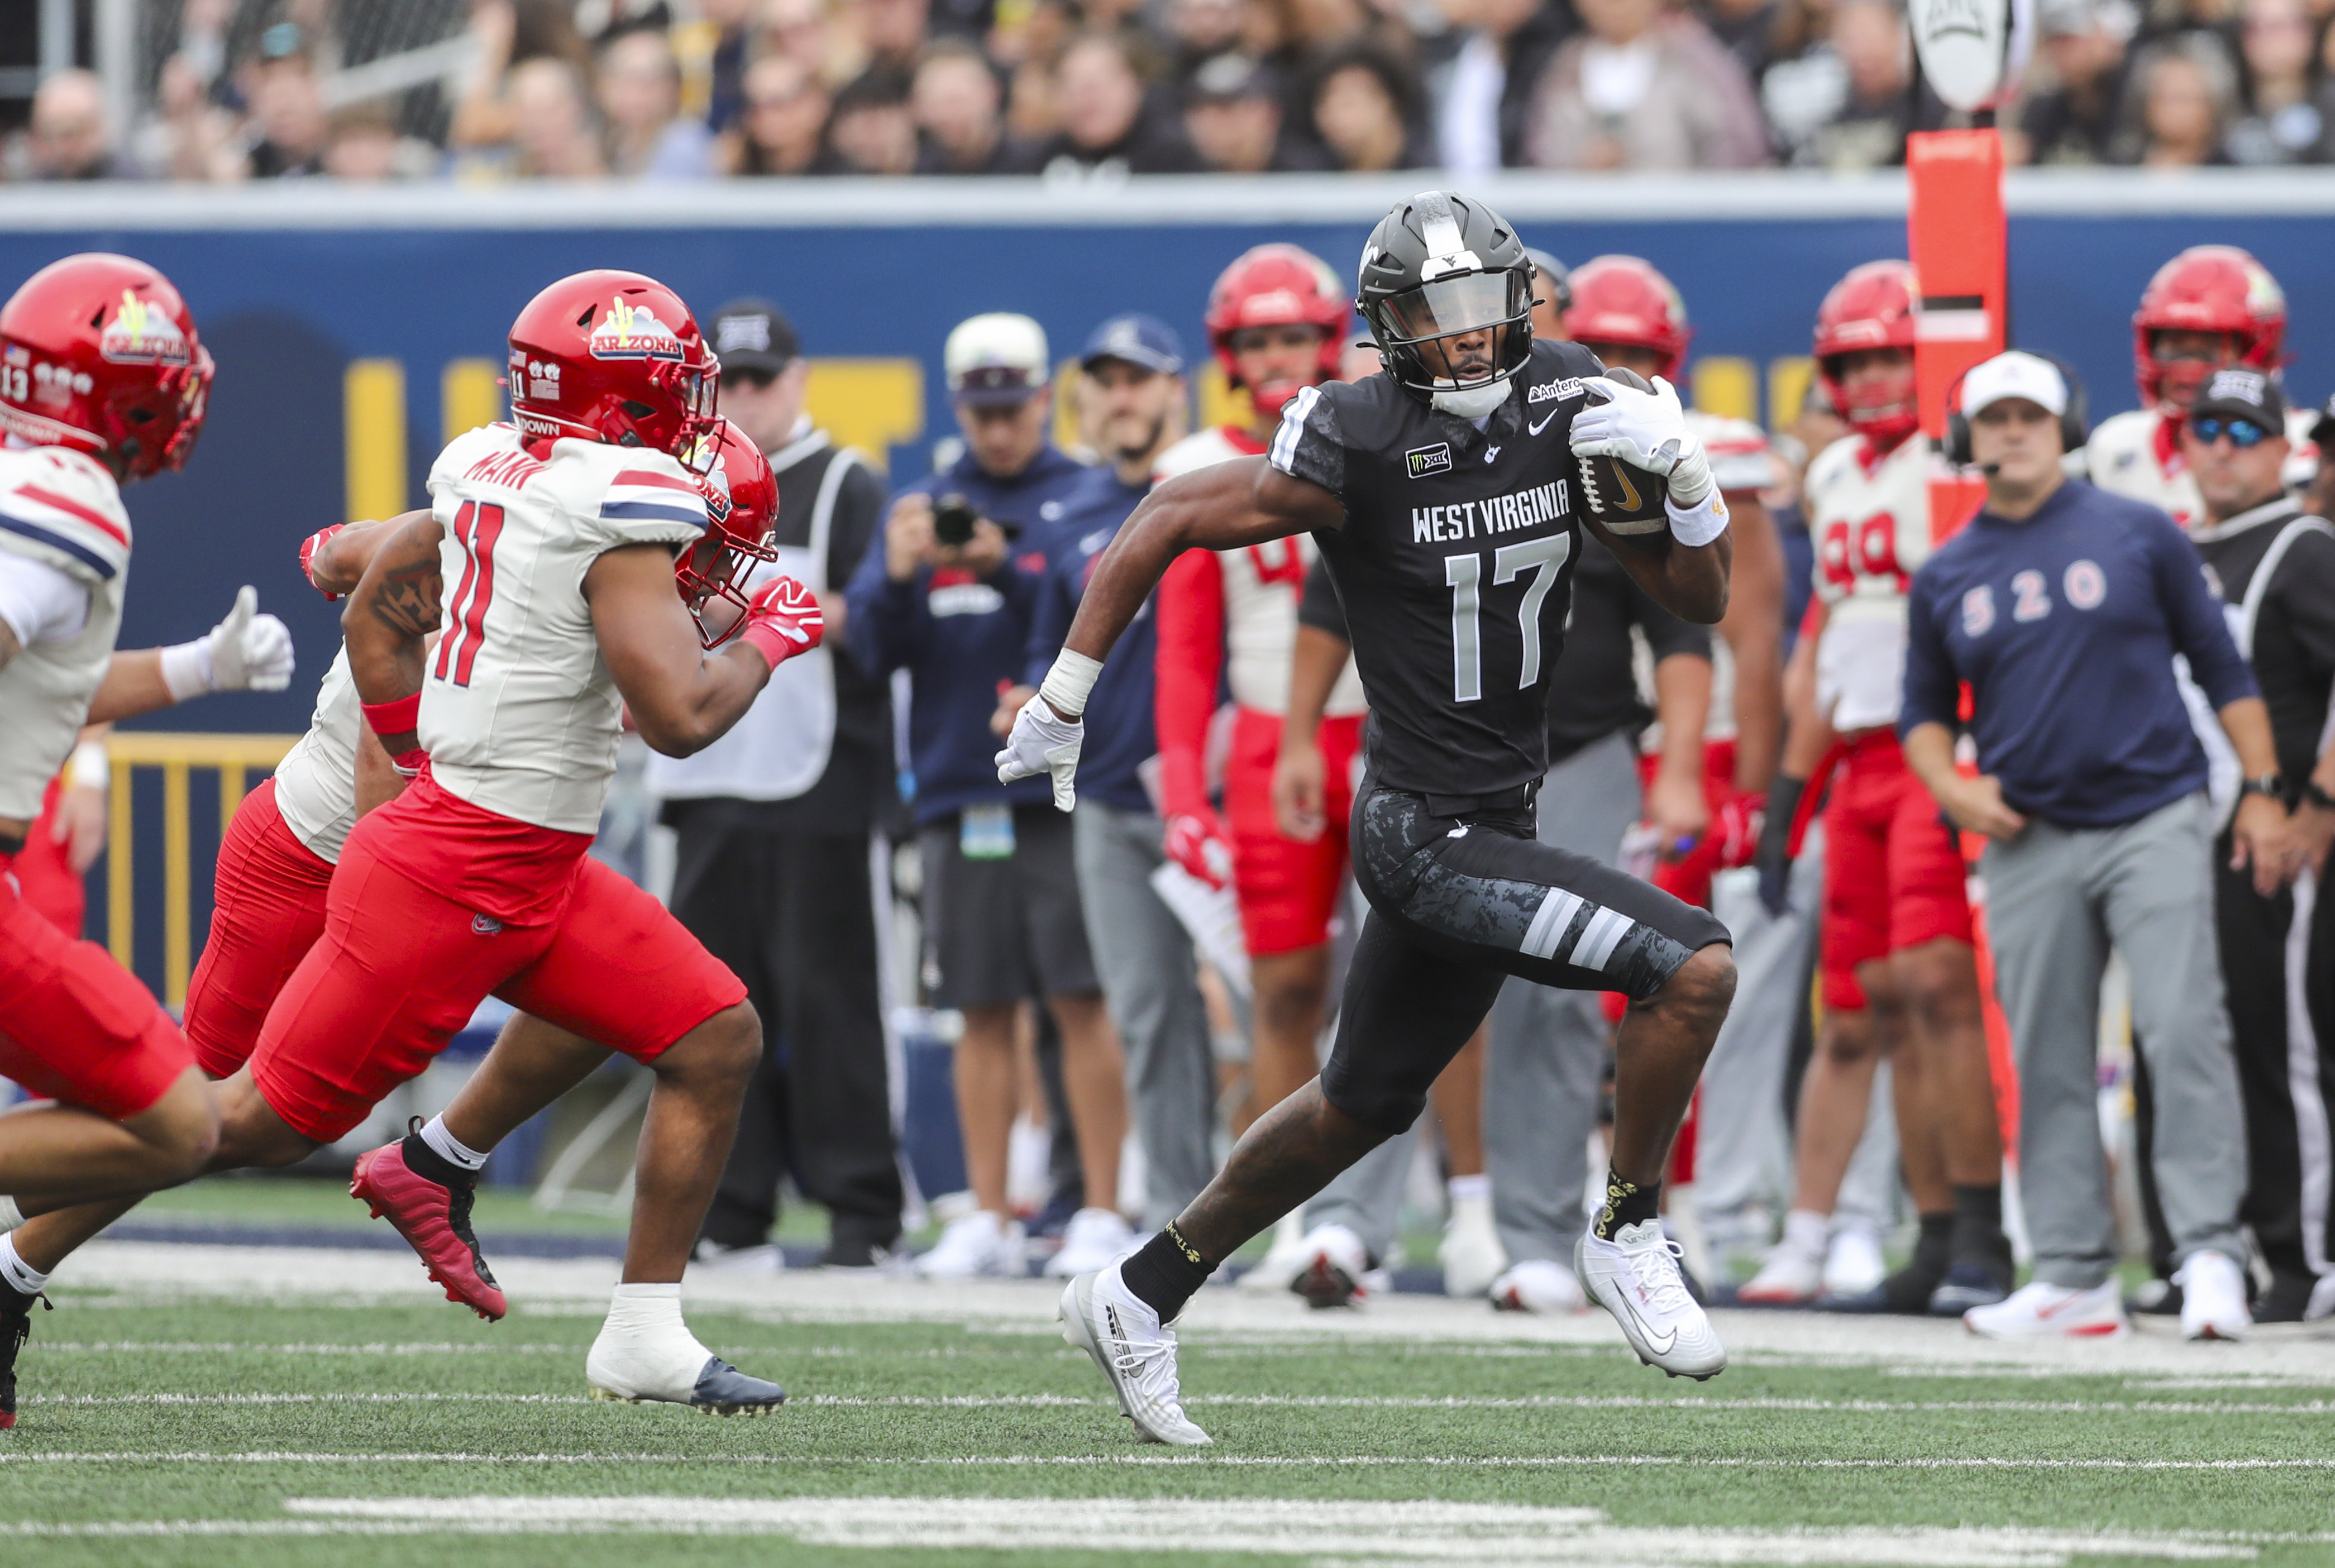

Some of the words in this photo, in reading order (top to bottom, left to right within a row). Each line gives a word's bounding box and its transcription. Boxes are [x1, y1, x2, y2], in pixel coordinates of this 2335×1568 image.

[2, 364, 28, 403] 13
[511, 370, 526, 399] 11
[1541, 379, 1580, 398] Antero
[1558, 389, 1583, 399] Resources
[520, 418, 560, 436] DOWN
[462, 450, 553, 490] MANN
[1412, 501, 1476, 543] WEST
[1479, 478, 1570, 535] VIRGINIA
[434, 499, 505, 688] 11
[1444, 530, 1571, 702] 17
